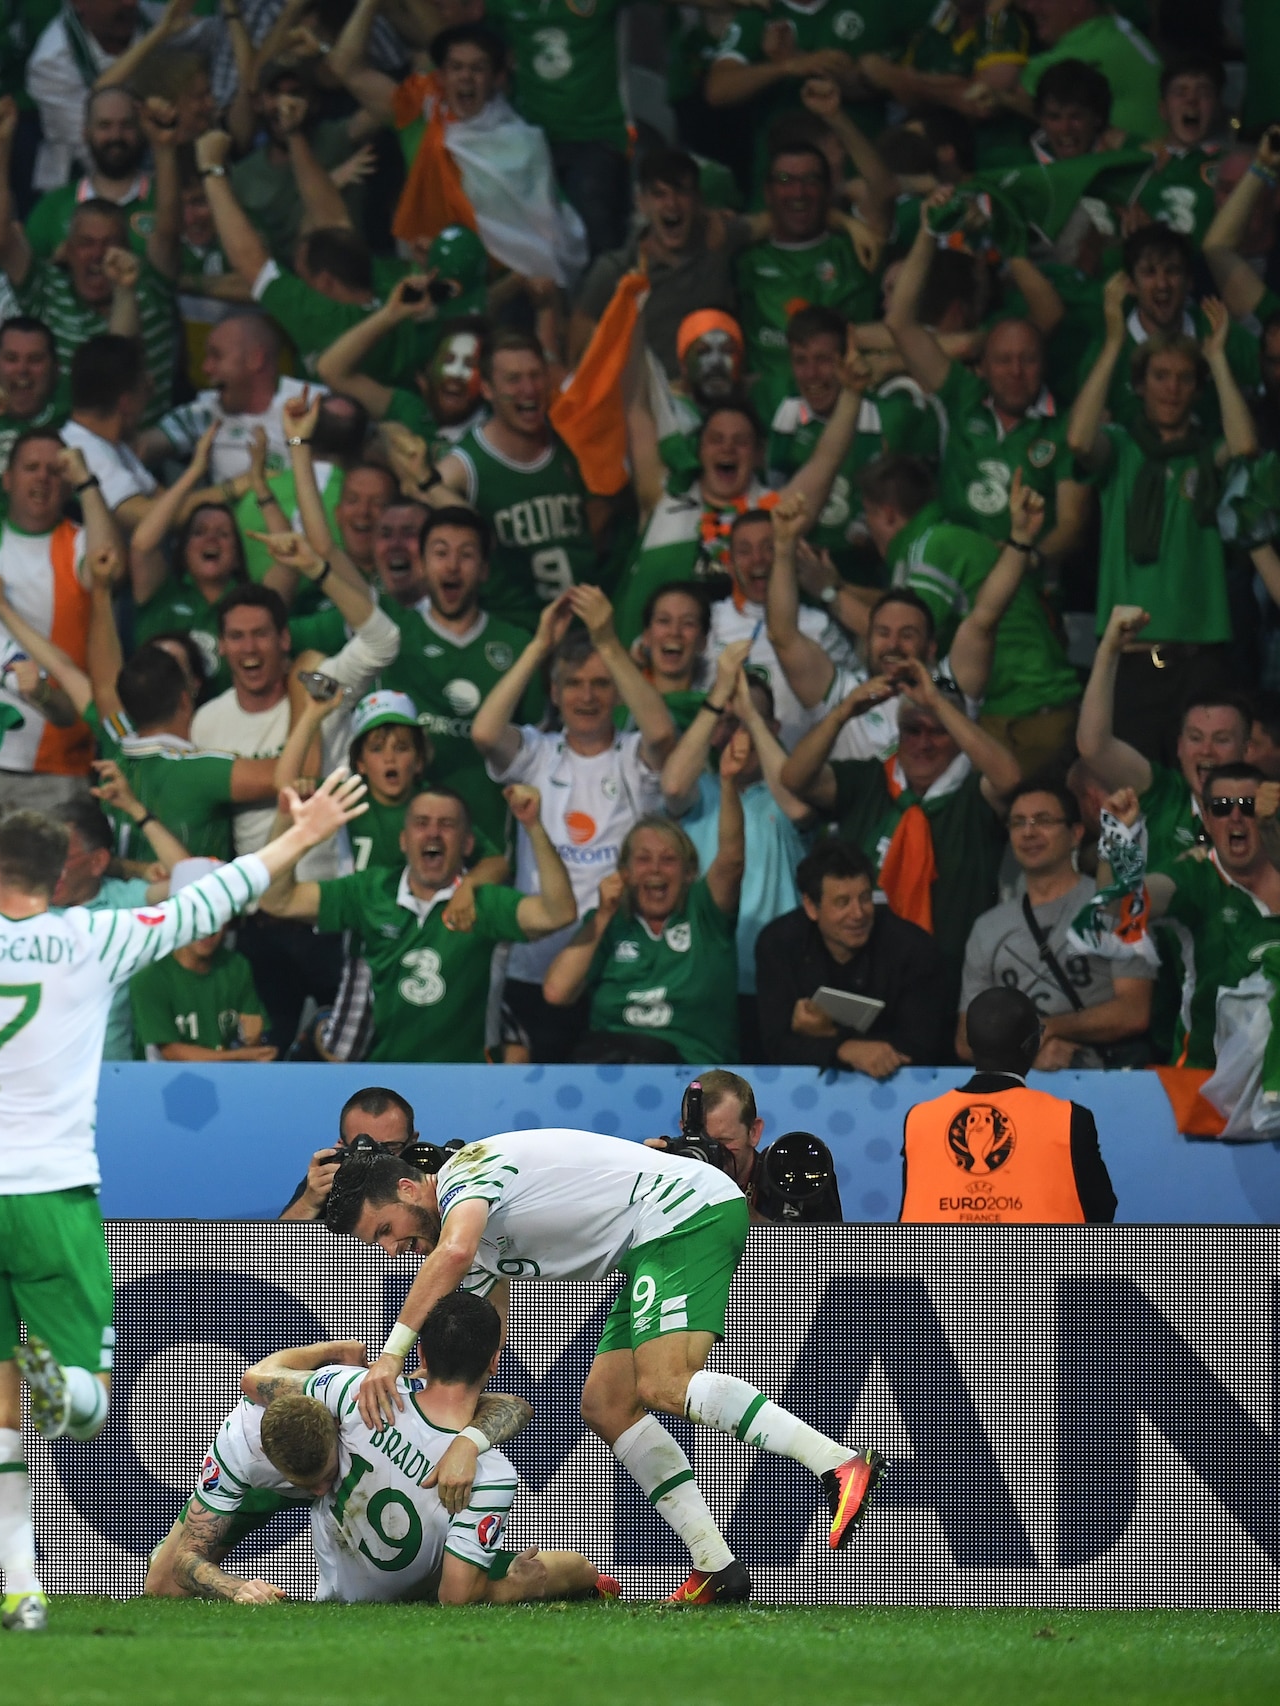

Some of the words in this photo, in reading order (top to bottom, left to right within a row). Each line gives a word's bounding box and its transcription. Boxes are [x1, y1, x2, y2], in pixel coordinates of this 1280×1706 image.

[967, 458, 1012, 516] 3
[493, 494, 583, 546] CELTICS
[532, 547, 572, 602] 9
[398, 947, 446, 1007] 3
[622, 986, 674, 1028] 3
[939, 1197, 1023, 1211] EURO2016
[965, 1180, 995, 1194] UEFA
[959, 1213, 1001, 1222] FRANCE
[633, 1275, 656, 1319] 9
[369, 1419, 435, 1488] BRADY
[330, 1453, 423, 1571] 19
